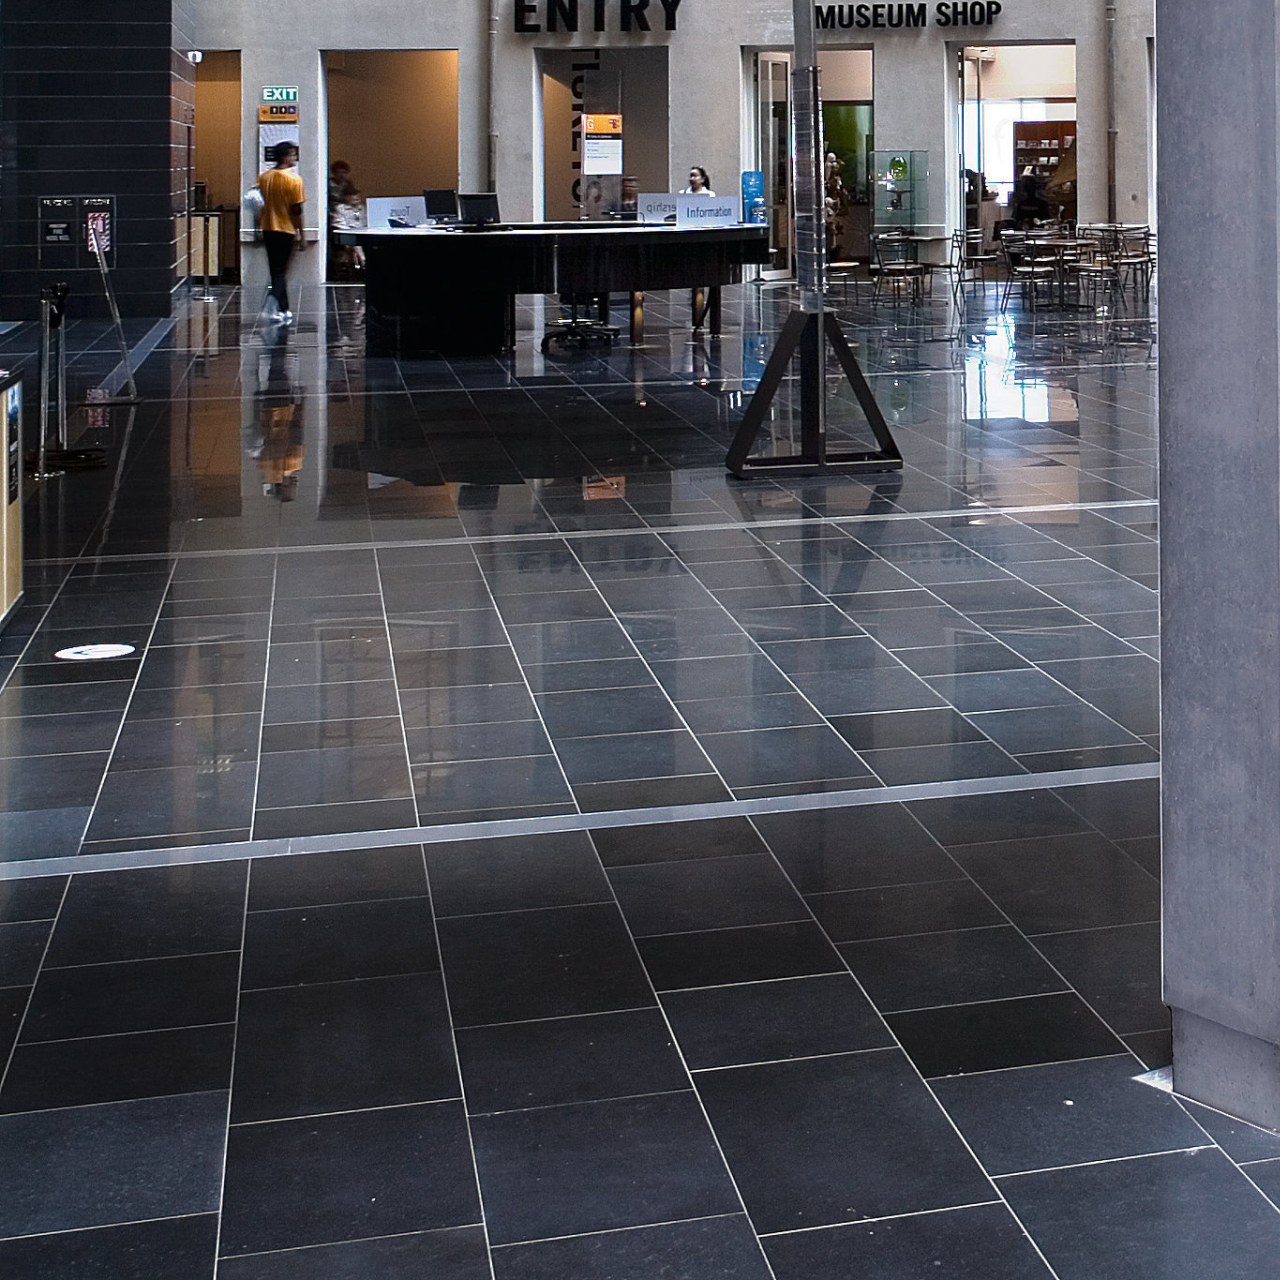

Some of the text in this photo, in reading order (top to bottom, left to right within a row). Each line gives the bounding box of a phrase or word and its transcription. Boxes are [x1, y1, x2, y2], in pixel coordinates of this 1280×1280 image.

[815, 1, 1002, 29] MUSEUM SHOP
[263, 88, 297, 100] EXIT
[587, 119, 594, 129] G
[687, 206, 731, 218] Information
